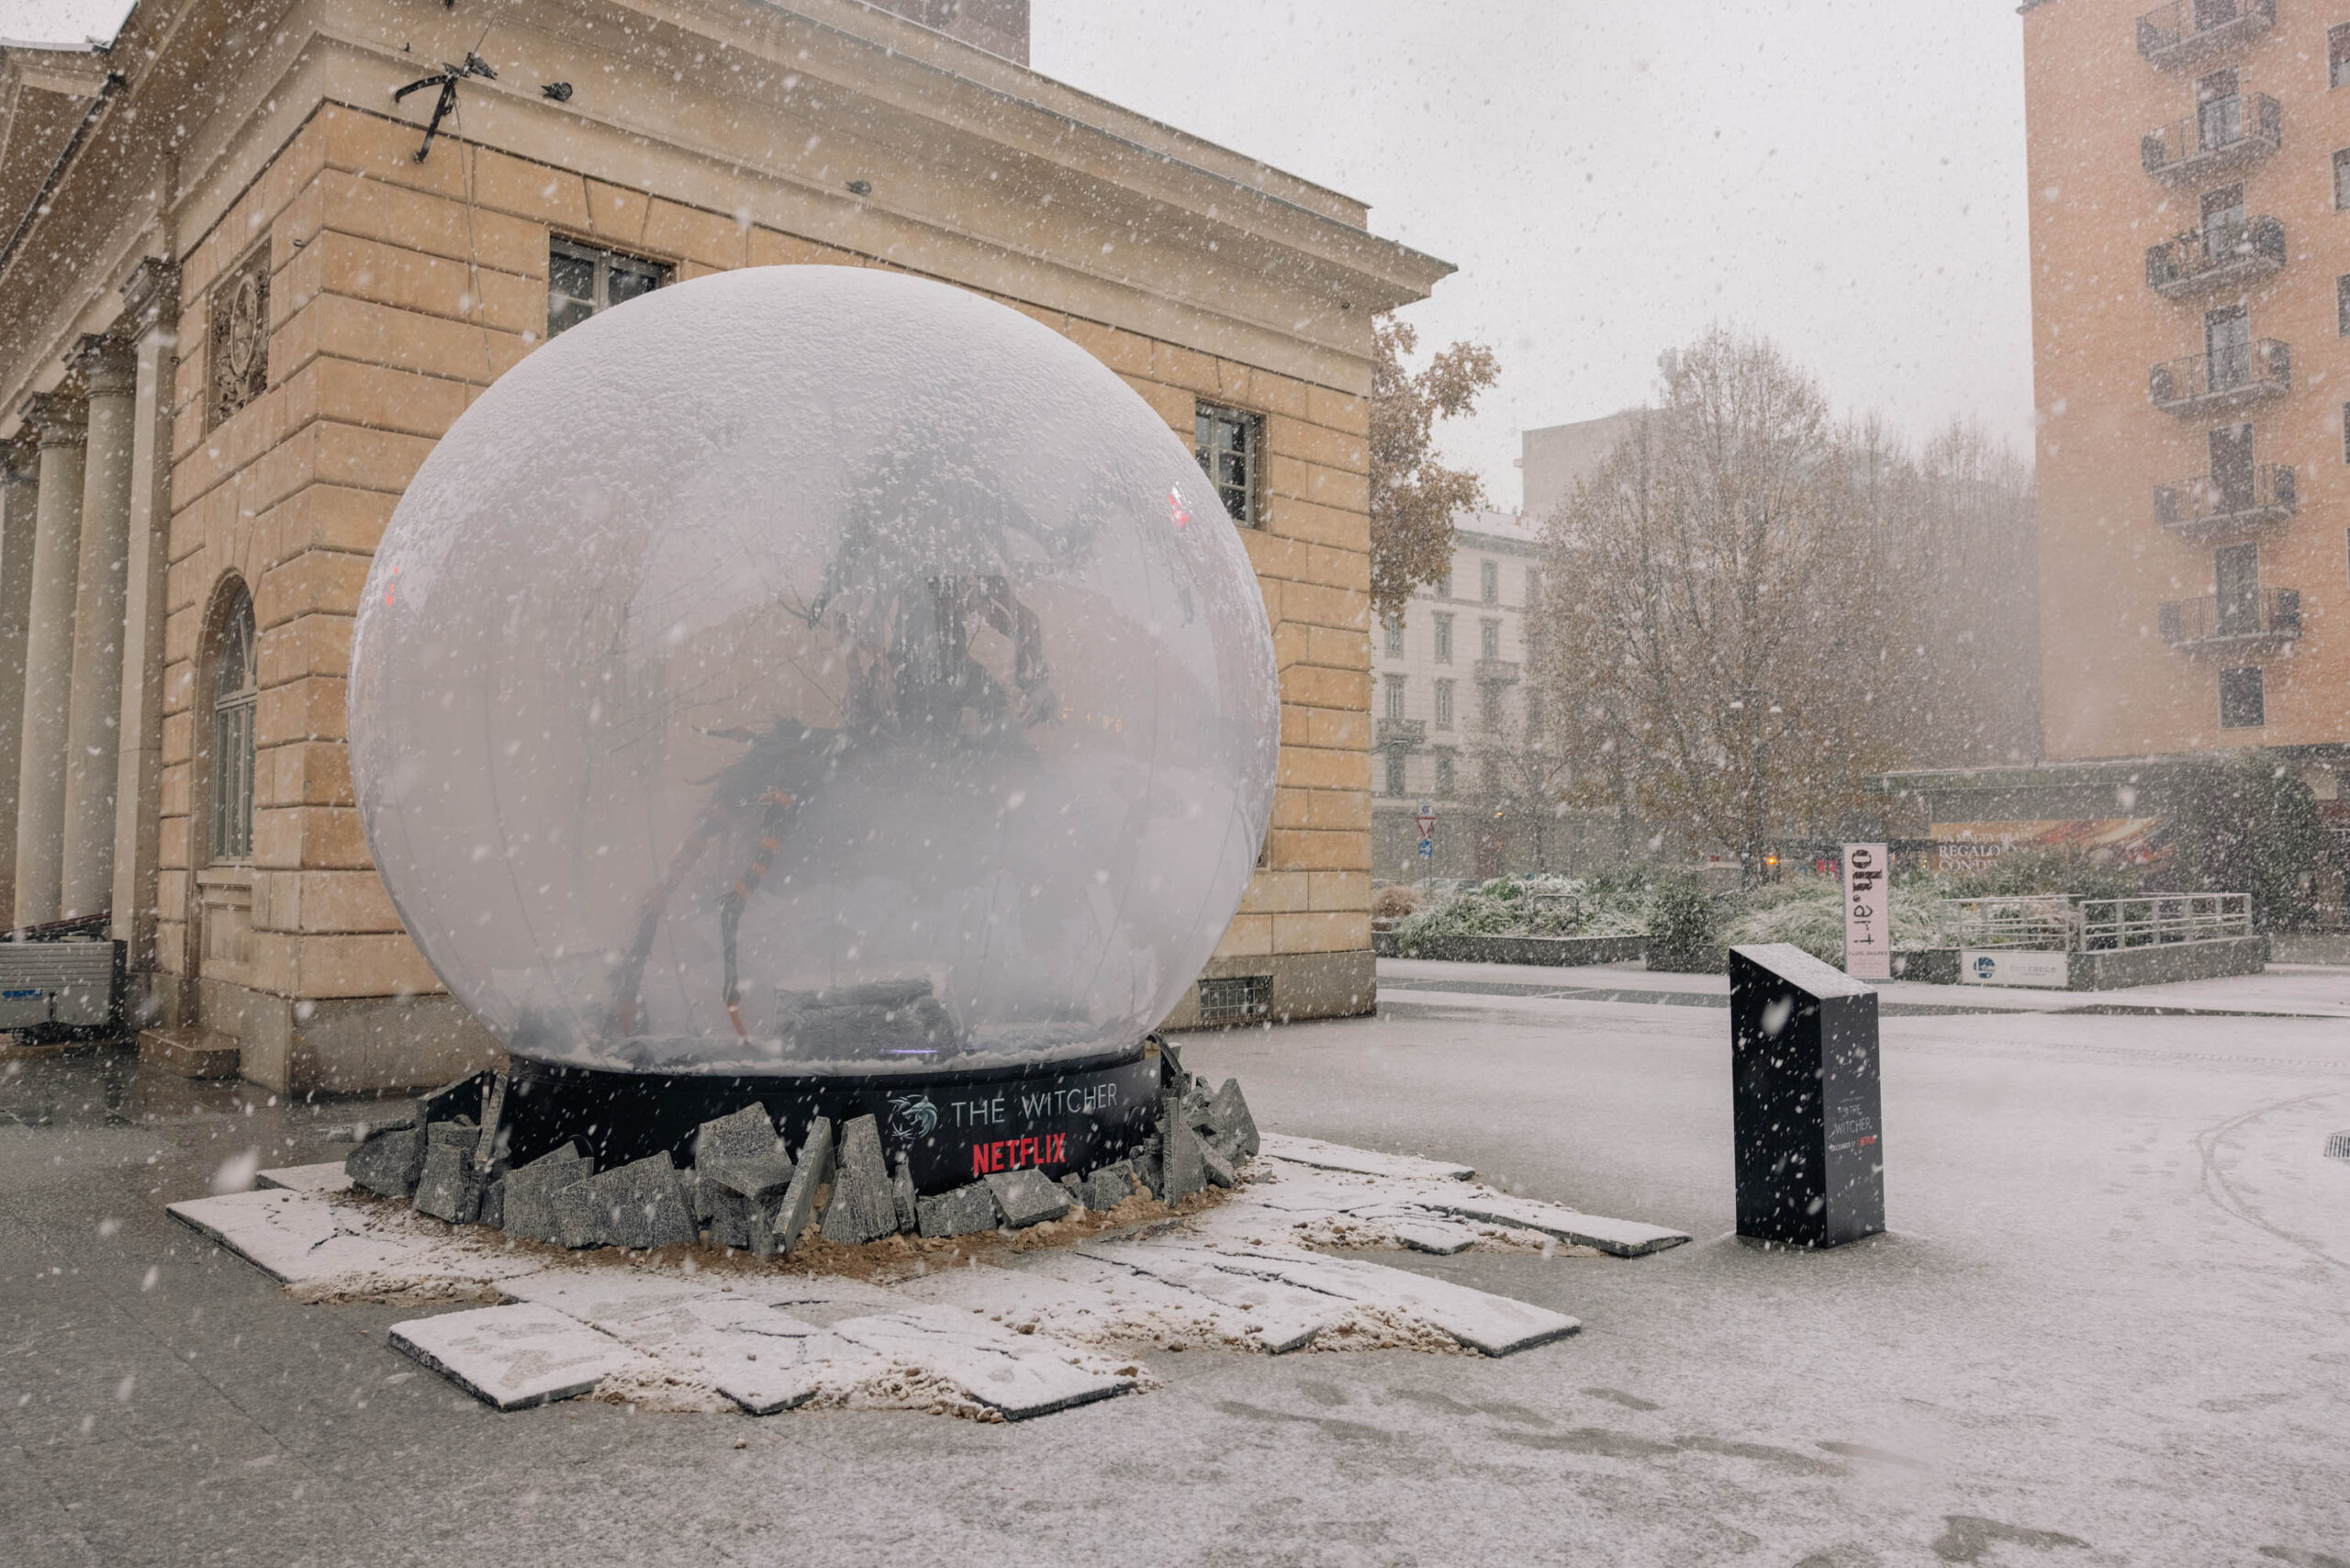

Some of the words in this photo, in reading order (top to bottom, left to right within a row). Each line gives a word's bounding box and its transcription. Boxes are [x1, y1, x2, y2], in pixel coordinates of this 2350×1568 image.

[1939, 845, 2001, 859] REGALO
[1852, 849, 1883, 945] oh.art
[951, 1098, 1005, 1127] THE
[1022, 1082, 1117, 1120] WITCHER
[1834, 1116, 1872, 1135] WITCHER
[973, 1132, 1066, 1178] NETFLIX
